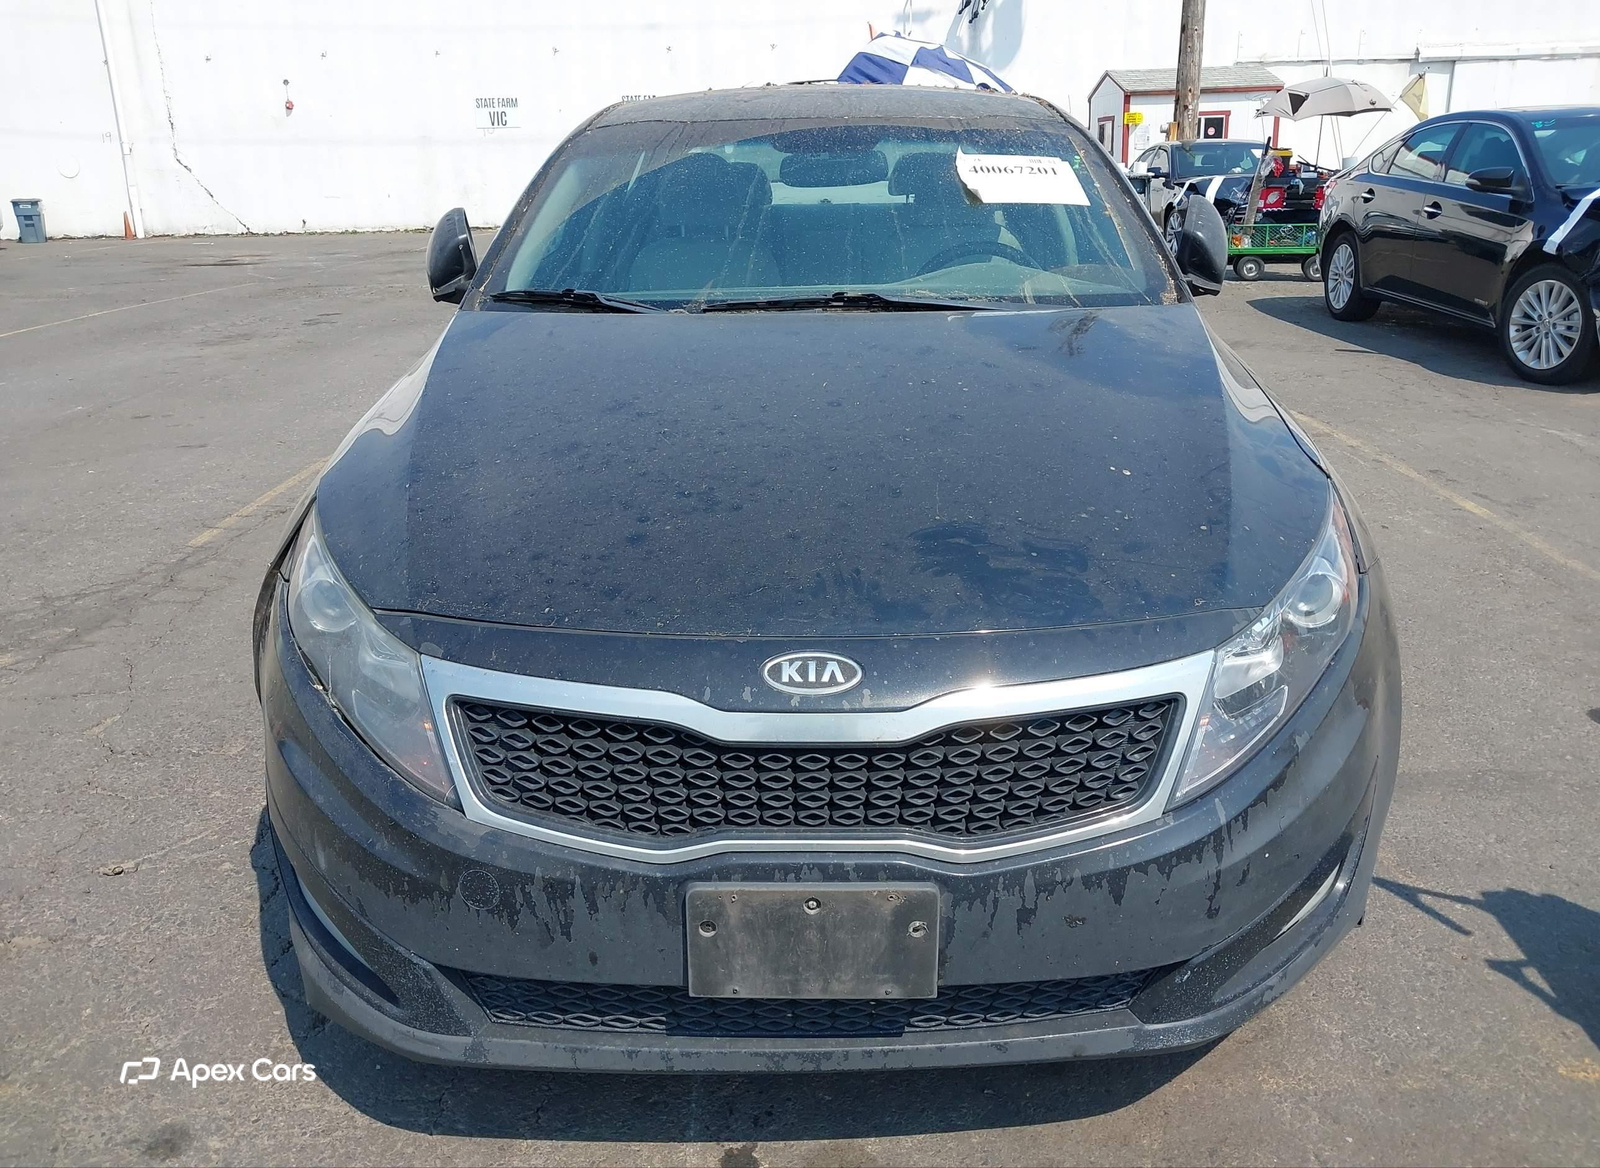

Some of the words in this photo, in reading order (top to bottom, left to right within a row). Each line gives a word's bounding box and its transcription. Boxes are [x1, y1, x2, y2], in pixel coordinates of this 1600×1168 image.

[475, 97, 496, 109] STATE
[497, 97, 519, 109] FARM
[488, 110, 508, 127] VIC
[101, 131, 112, 144] 19
[968, 164, 1058, 176] 40067201
[781, 661, 845, 683] KIA
